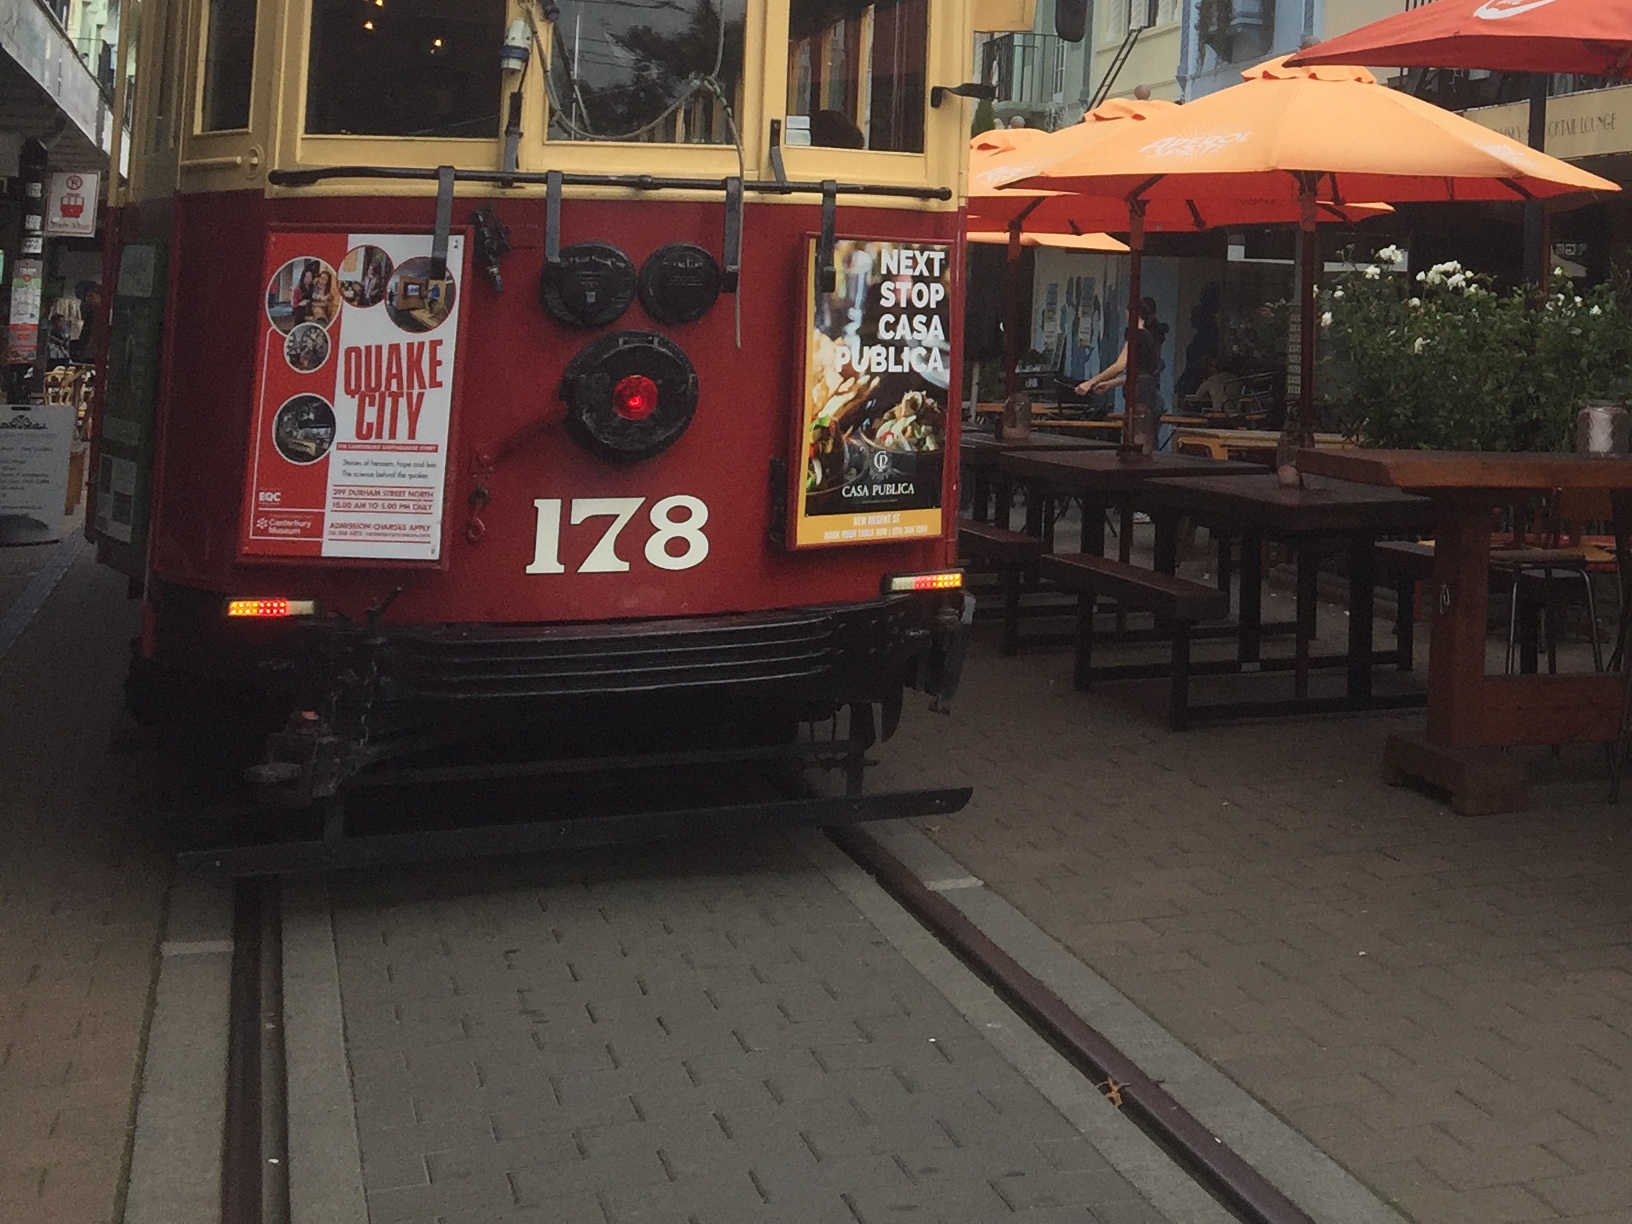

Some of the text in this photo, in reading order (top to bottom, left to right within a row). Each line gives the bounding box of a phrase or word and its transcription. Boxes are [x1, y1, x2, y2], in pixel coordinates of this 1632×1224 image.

[1548, 112, 1617, 138] CKTAIL LOUNGE
[880, 248, 945, 277] NEXT
[880, 280, 945, 309] STOP
[878, 313, 945, 340] CASA
[344, 339, 443, 398] QUAKE
[835, 345, 945, 373] PUBLICA
[355, 390, 425, 440] CITY
[353, 470, 374, 478] science
[376, 470, 396, 478] behind
[396, 460, 411, 469] hope
[259, 491, 281, 502] EQC
[348, 489, 380, 497] DURHAM
[842, 482, 915, 497] CASA PUBLICA
[268, 527, 301, 535] Museum
[269, 518, 311, 529] Canterbury
[329, 522, 431, 532] ADMISSION CHARGES APPLY
[526, 494, 710, 574] 178
